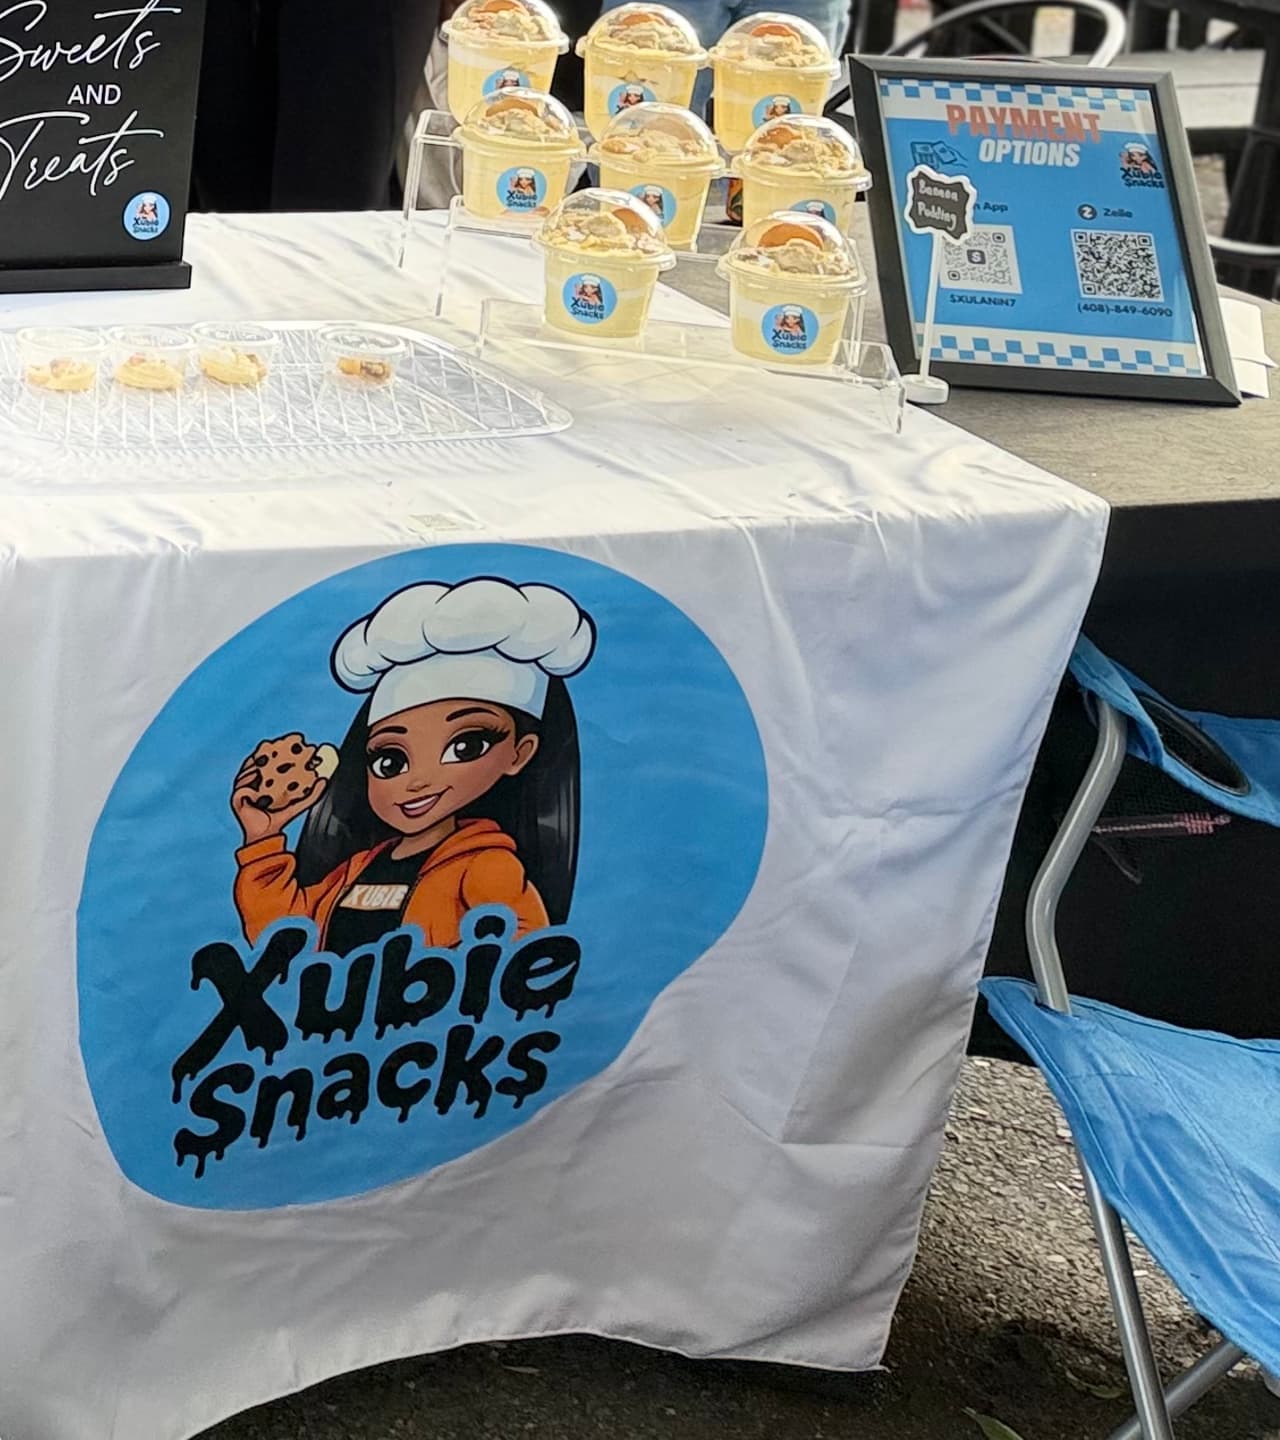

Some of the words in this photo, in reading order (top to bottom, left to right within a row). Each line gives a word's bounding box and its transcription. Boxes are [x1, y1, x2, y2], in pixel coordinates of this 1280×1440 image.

[67, 83, 123, 106] AND
[945, 103, 1102, 144] PAYMENT
[978, 138, 1081, 168] OPTIONS
[1120, 167, 1163, 180] Xubie
[917, 201, 957, 231] Pudding
[983, 202, 1009, 213] App
[1103, 207, 1133, 218] Zelle
[571, 297, 605, 311] Xubie
[771, 328, 807, 341] Xubie
[172, 914, 582, 1105] Xubie
[172, 1022, 562, 1180] Snacks
